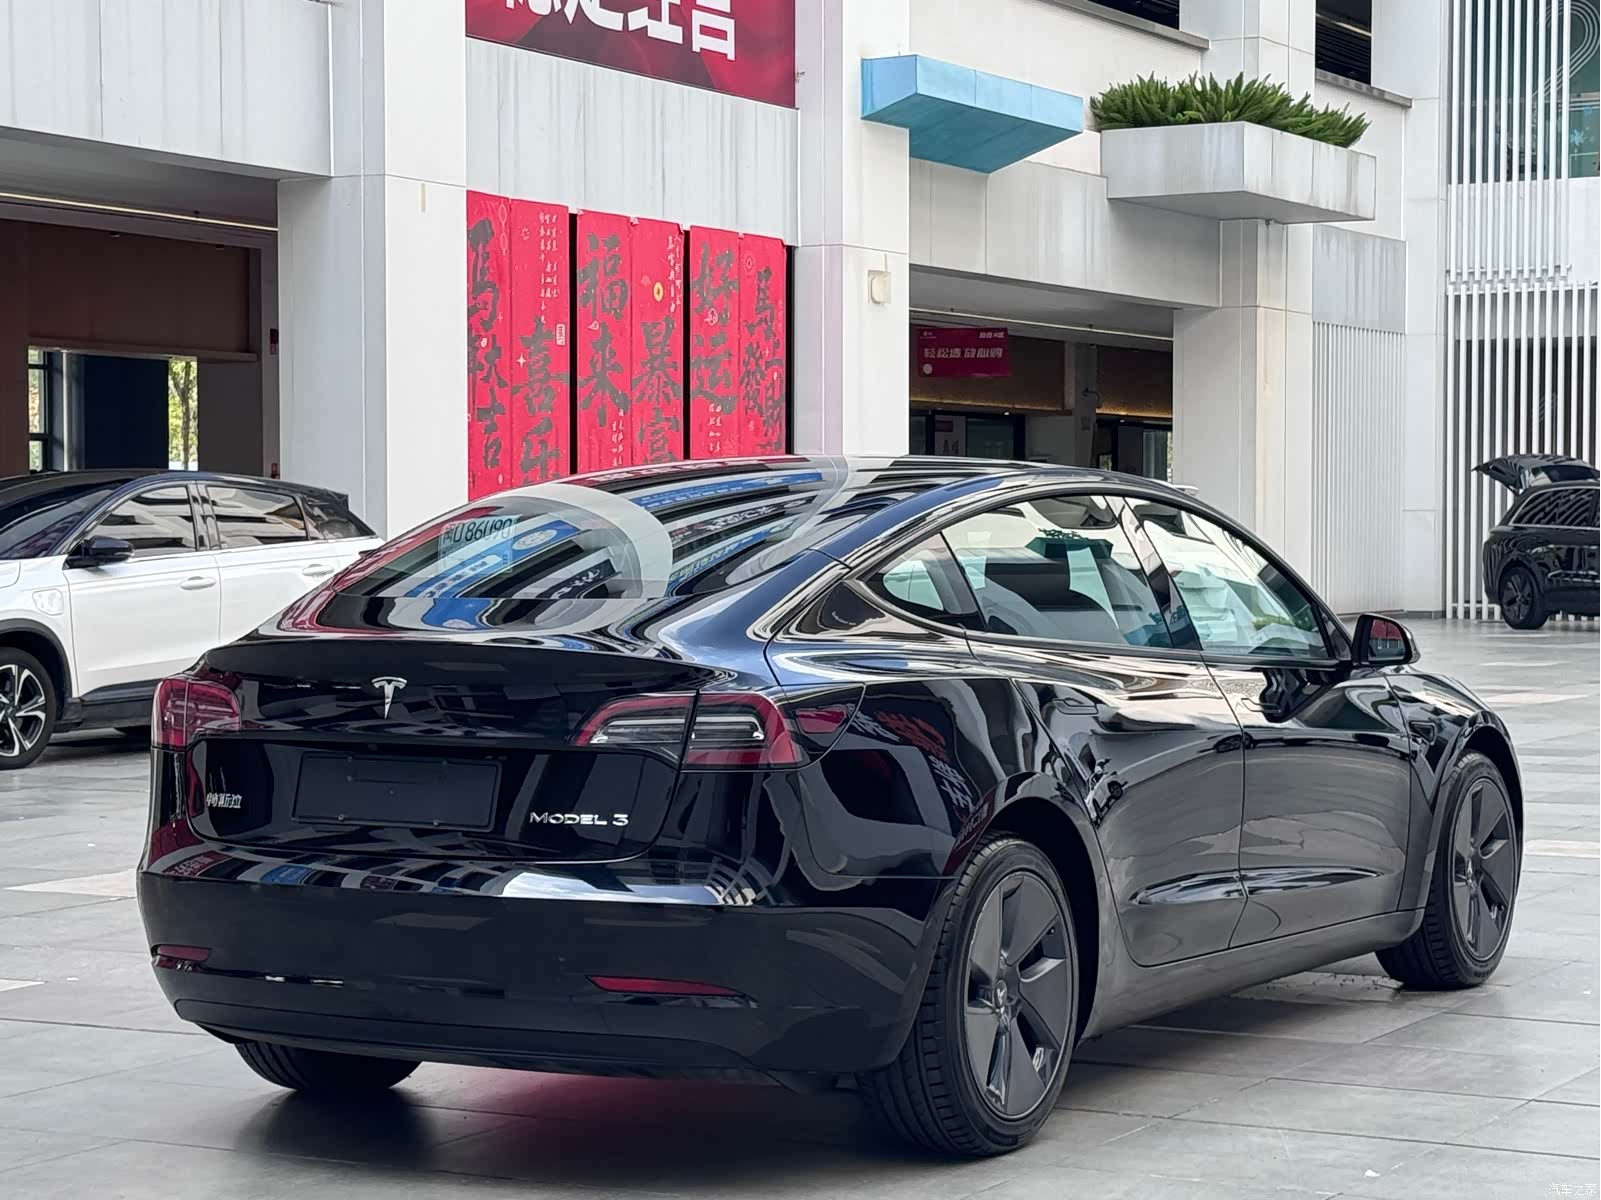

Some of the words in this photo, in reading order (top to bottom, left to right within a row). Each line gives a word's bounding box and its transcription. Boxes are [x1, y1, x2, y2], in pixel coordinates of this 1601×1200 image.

[206, 792, 242, 809] 特斯拉
[529, 811, 608, 826] MODEL
[612, 813, 629, 827] 3
